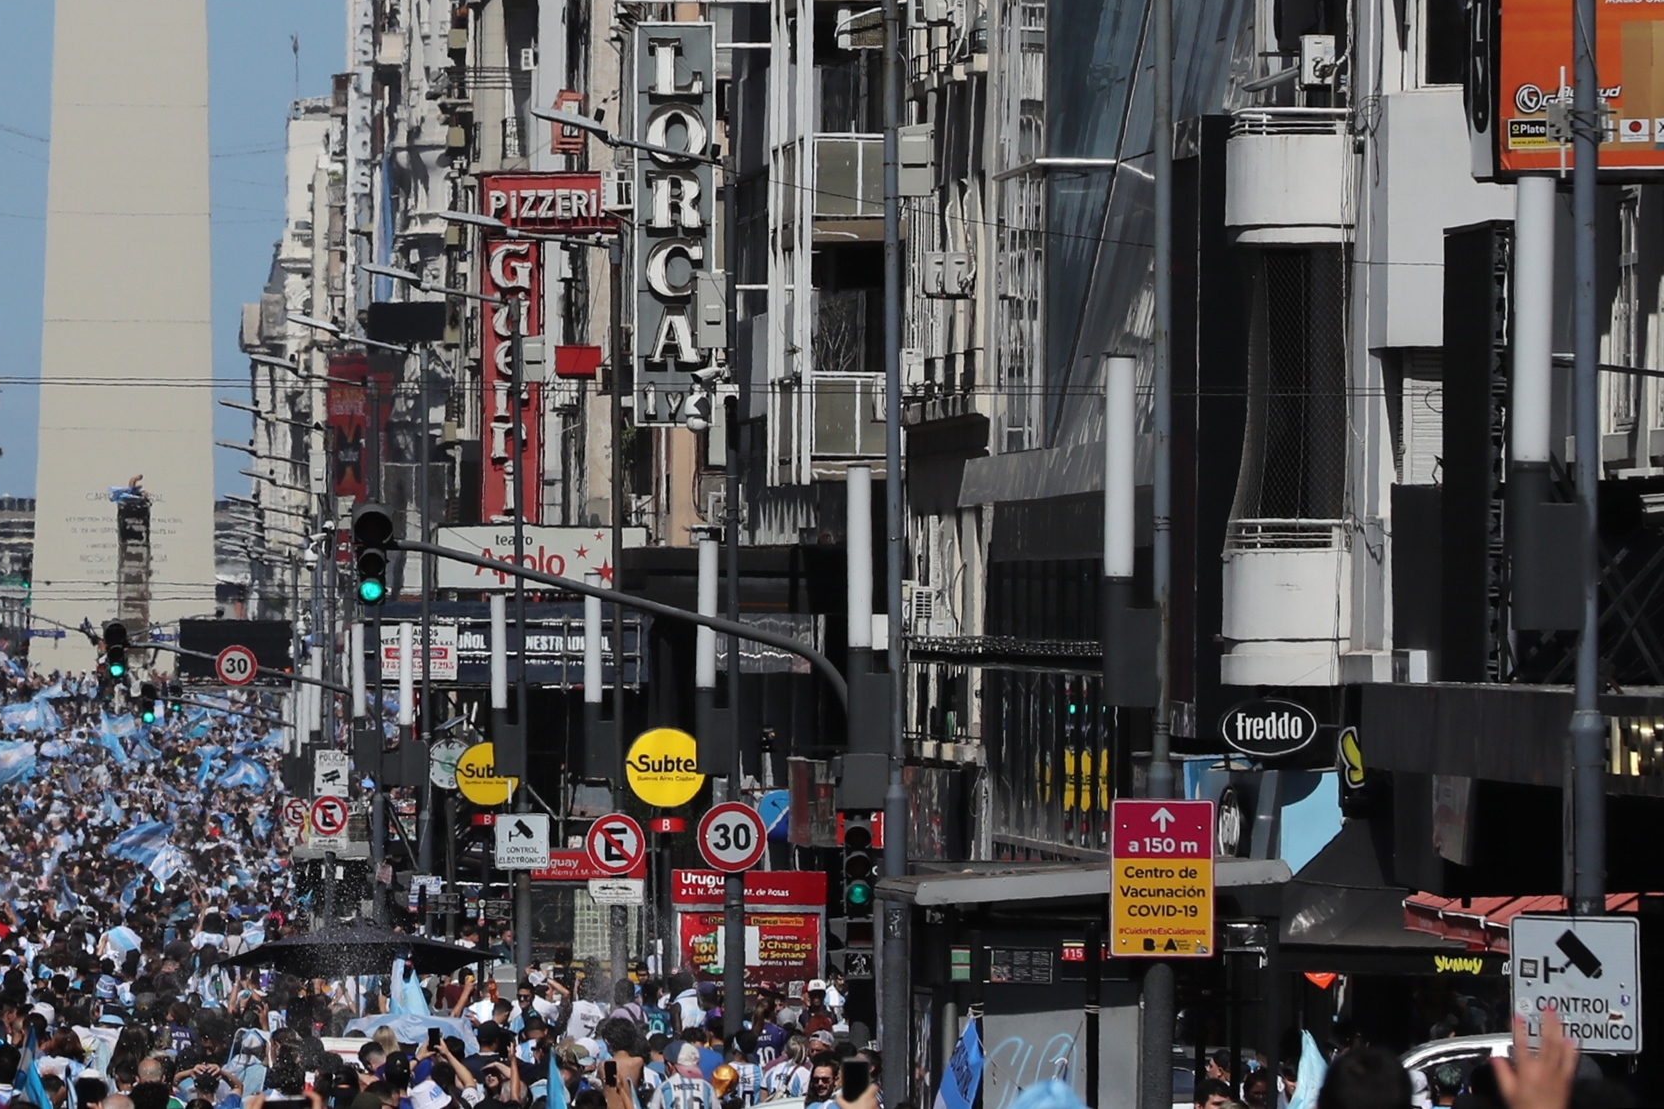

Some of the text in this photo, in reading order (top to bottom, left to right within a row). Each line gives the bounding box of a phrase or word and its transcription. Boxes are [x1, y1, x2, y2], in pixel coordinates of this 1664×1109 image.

[488, 188, 605, 220] PIZZERI
[645, 37, 707, 365] LORCA
[225, 657, 248, 675] 30
[637, 754, 696, 773] Subte
[465, 763, 496, 779] Sub
[662, 819, 671, 831] B
[712, 823, 751, 851] 30
[505, 846, 540, 855] CONTROL
[1128, 837, 1198, 853] a 150 m
[497, 856, 547, 865] ELECTRONICO
[549, 858, 579, 869] guay
[1124, 866, 1198, 879] Centro de
[681, 872, 725, 887] Urugu
[1120, 885, 1206, 899] Vacunación
[1127, 904, 1198, 917] COVID-19
[767, 940, 813, 951] Changos
[769, 950, 807, 960] Semana
[1063, 948, 1083, 958] 115
